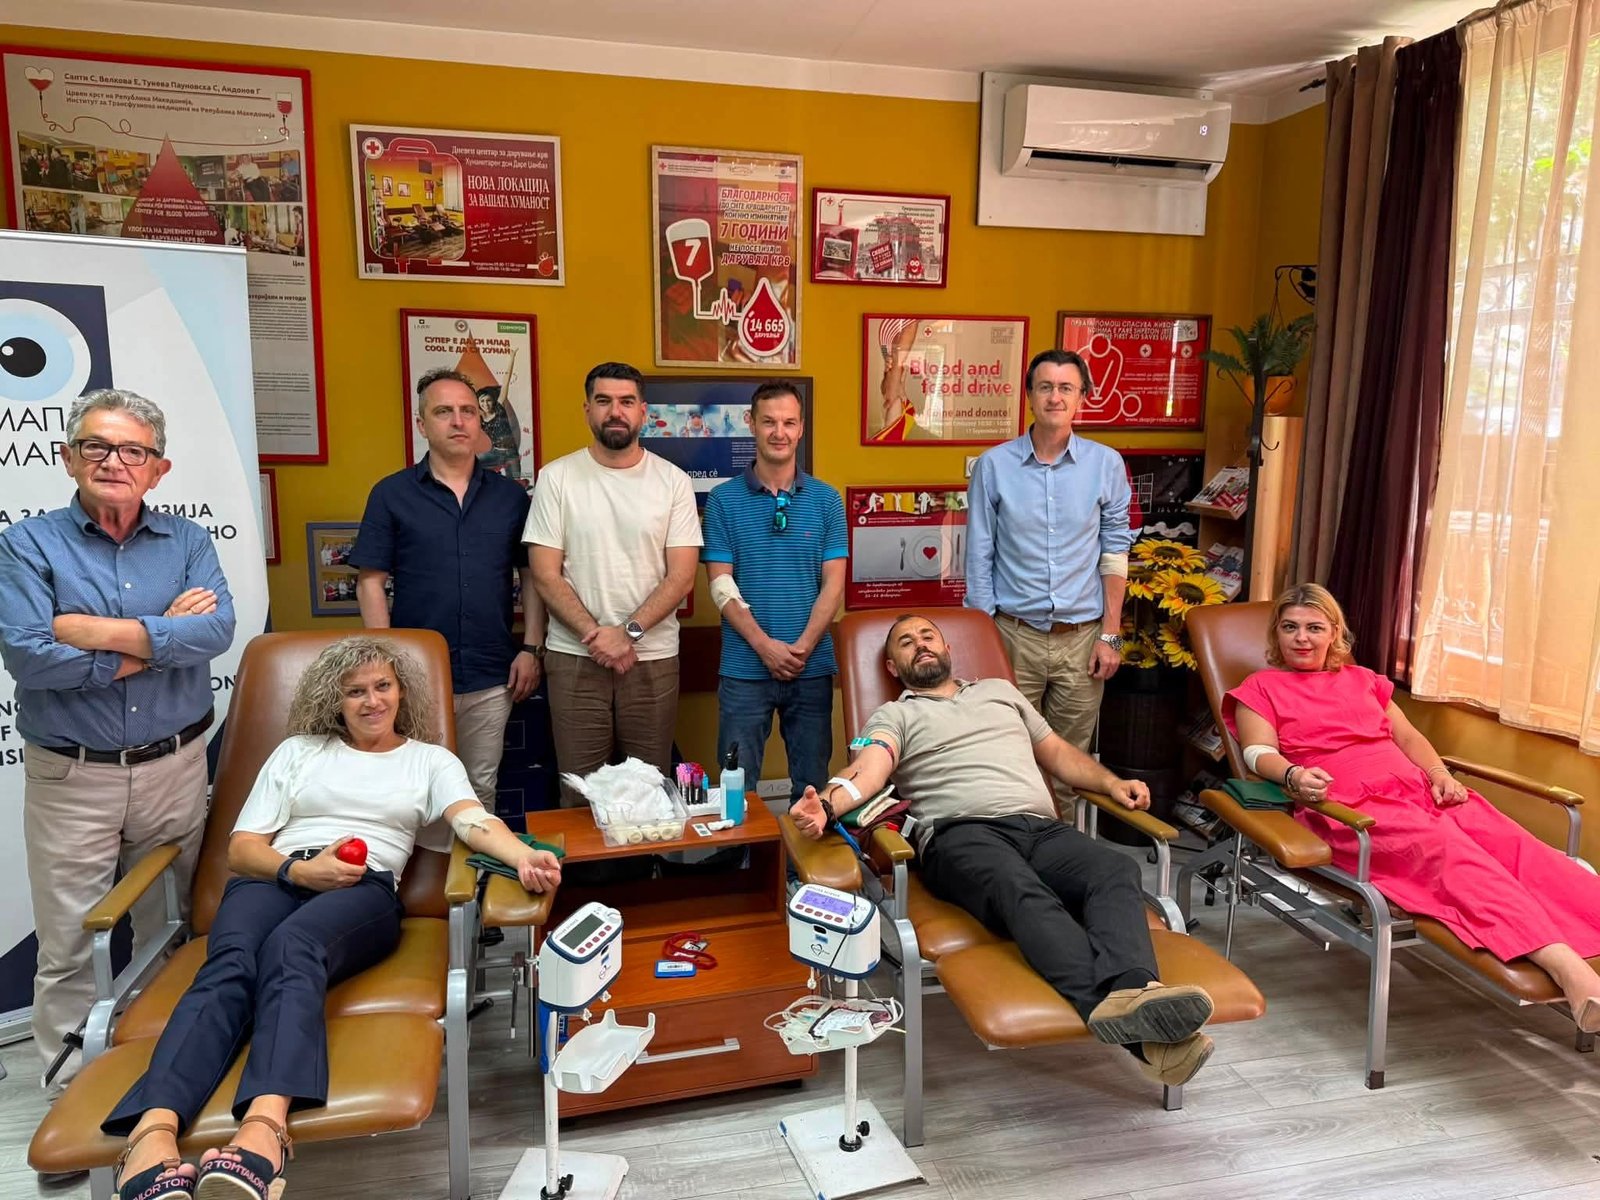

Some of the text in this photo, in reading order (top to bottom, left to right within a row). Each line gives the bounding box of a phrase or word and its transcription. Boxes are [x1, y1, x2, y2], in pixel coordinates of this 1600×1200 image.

[171, 81, 211, 91] Пауновска
[222, 85, 255, 95] Андонов
[115, 94, 151, 102] Република
[1199, 124, 1208, 136] 19
[476, 148, 498, 157] центар
[467, 175, 550, 196] НОВА ЛОКАЦИЈА
[468, 193, 551, 210] ЗА ВАШАТА ХУМАНОСТ
[721, 188, 791, 202] БЛАГОДАРНОСТ
[153, 226, 162, 234] НА
[720, 223, 789, 241] 7 ГОДИНИ
[685, 238, 702, 266] 7
[770, 255, 791, 266] КРВ
[750, 318, 784, 332] 14 665
[1122, 320, 1152, 328] СПАСУВА
[424, 336, 450, 344] СУПЕР
[460, 338, 473, 346] ДА
[474, 338, 484, 346] СИ
[486, 338, 510, 348] МЛАД
[456, 346, 468, 354] ДА
[910, 358, 1001, 376] Blood and
[920, 378, 1012, 394] food drive
[955, 408, 974, 418] and
[975, 407, 1011, 418] donate!
[687, 471, 707, 479] пред
[207, 524, 238, 540] НО
[210, 674, 237, 691] ON
[0, 725, 11, 741] F
[0, 748, 24, 766] SI
